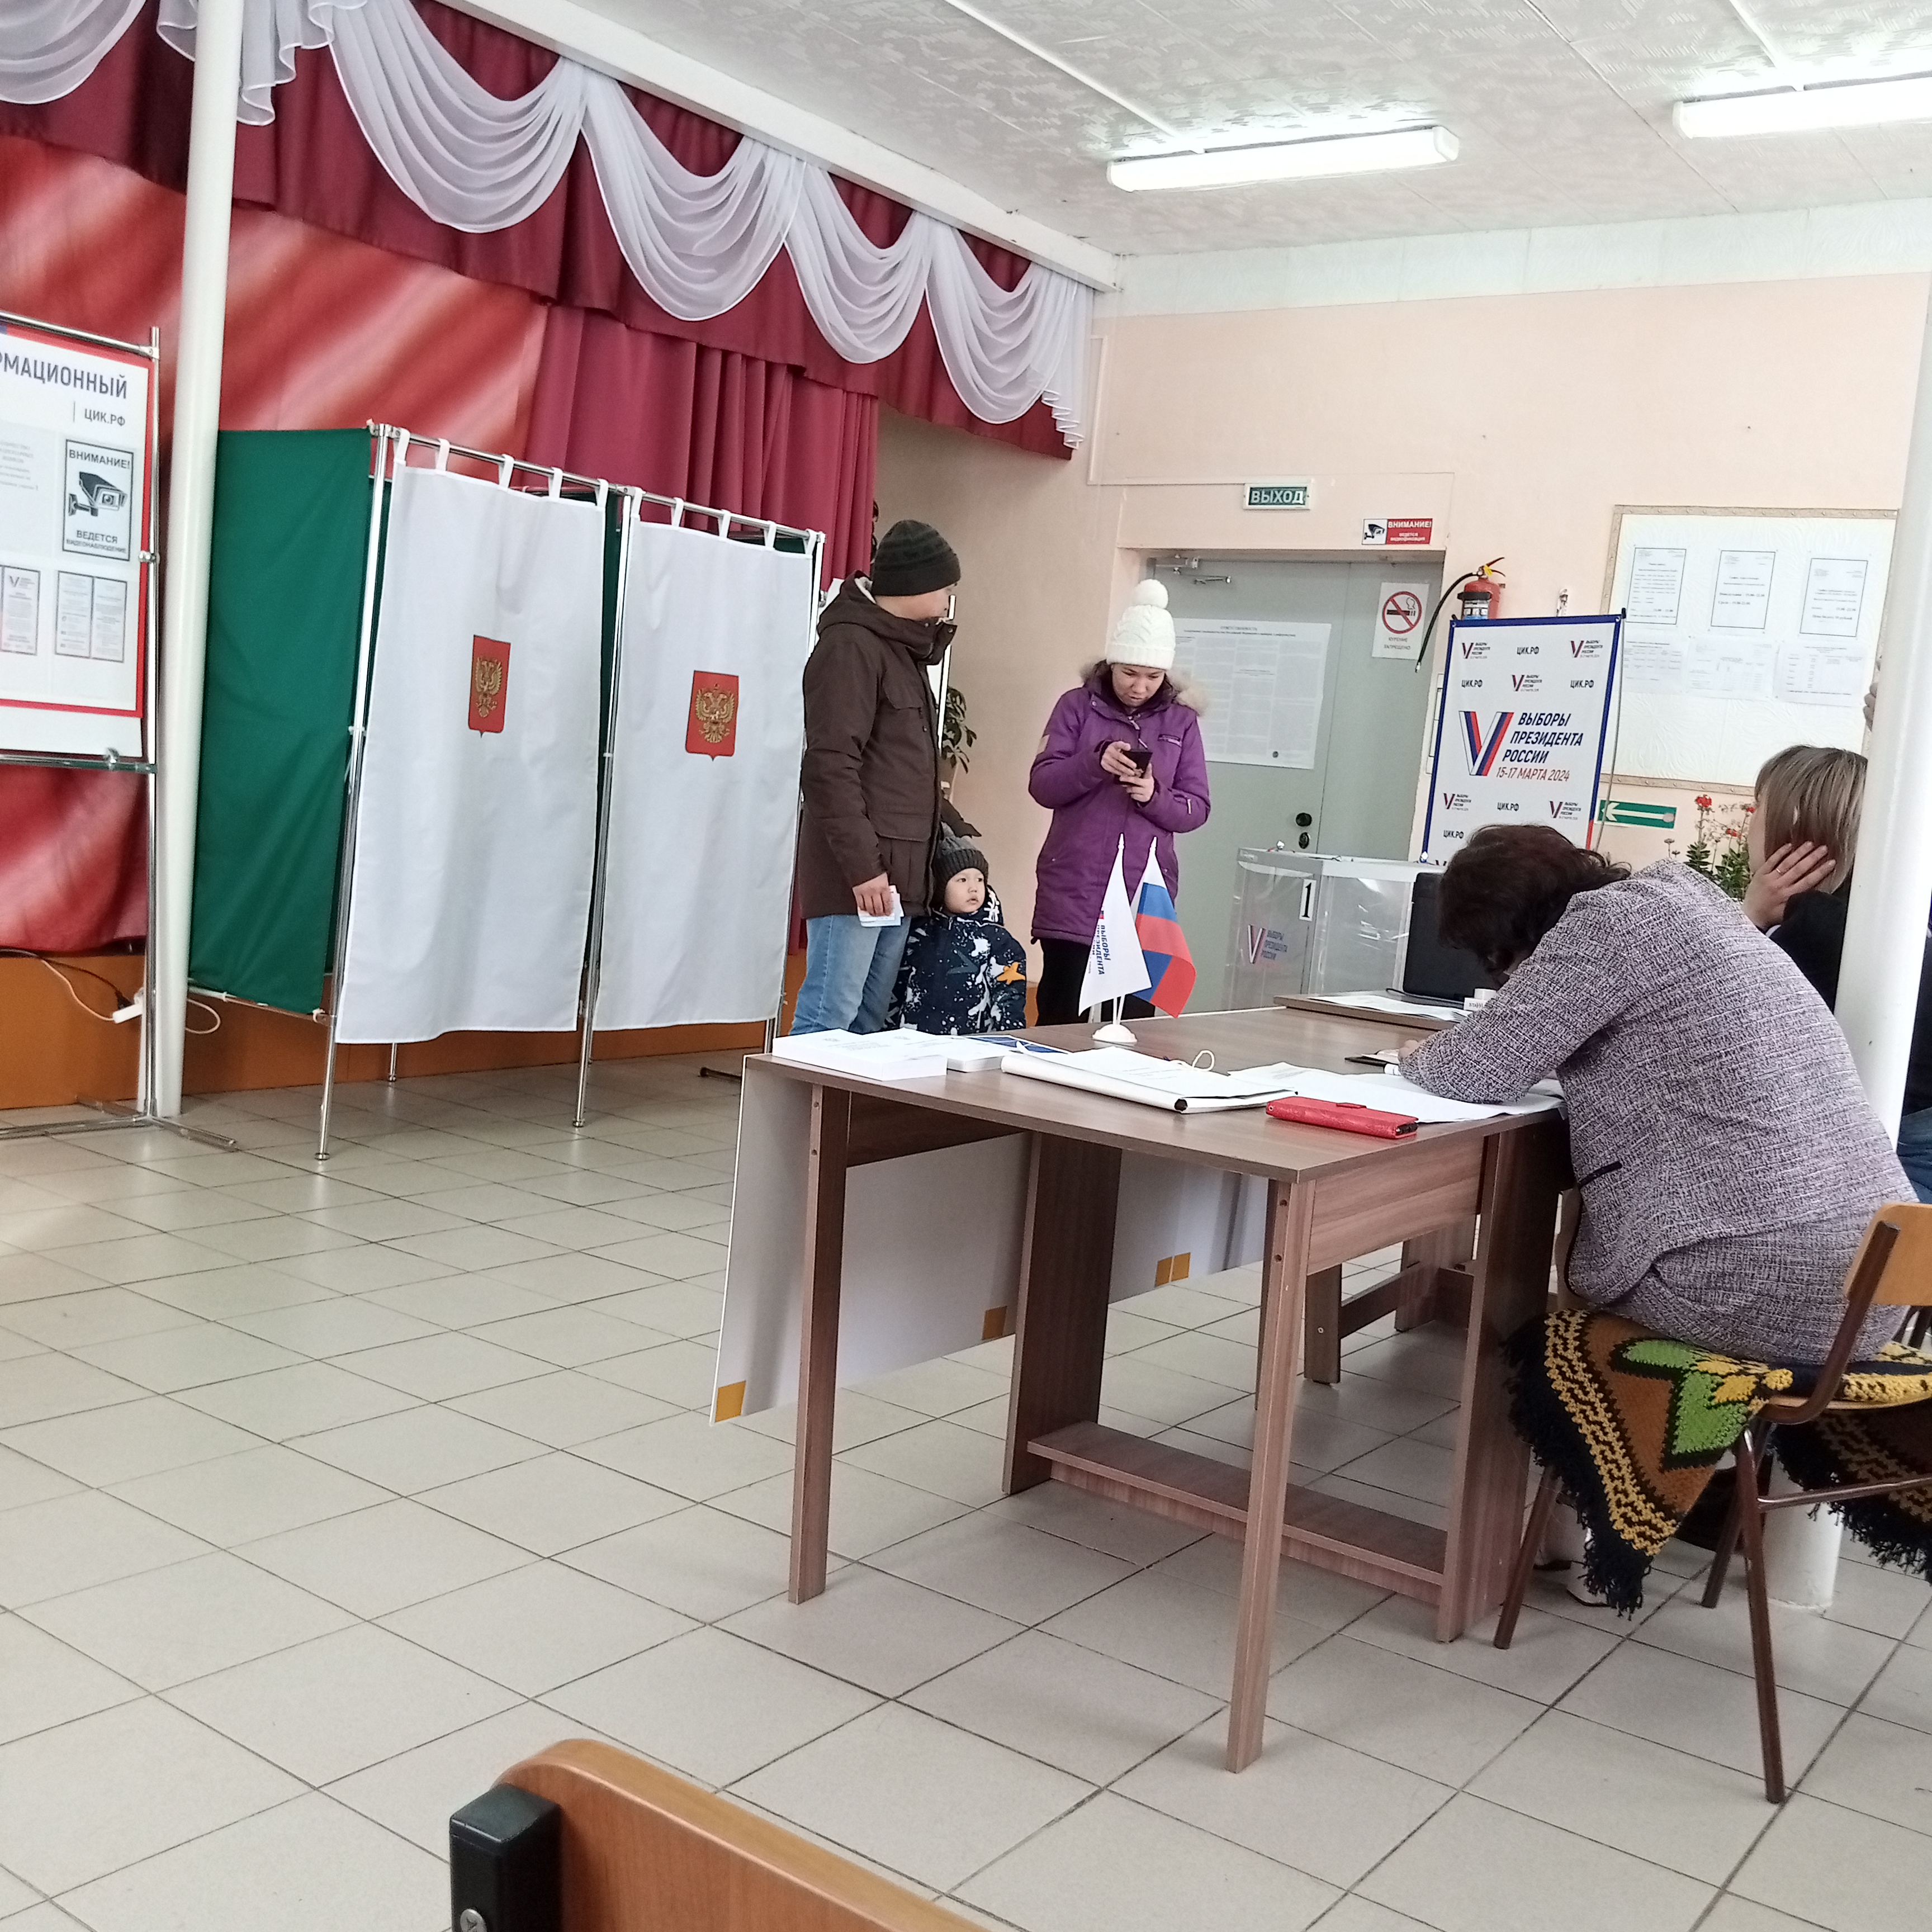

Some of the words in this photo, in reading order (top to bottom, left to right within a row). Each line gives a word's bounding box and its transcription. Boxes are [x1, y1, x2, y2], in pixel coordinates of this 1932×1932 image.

[0, 352, 127, 399] МАЦИОННЫЙ
[84, 409, 126, 427] ЦИК.РФ
[69, 449, 130, 469] ВНИМАНИЕ!
[1251, 490, 1304, 504] ВЫХОД
[77, 530, 117, 544] ВЕДЕТСЯ
[1517, 646, 1539, 655] ЦИК.РФ
[1461, 679, 1483, 688] ЦИК.РФ
[1570, 680, 1594, 689] ЦИК.РФ
[1518, 712, 1571, 727] ВЫБОРЫ
[1510, 731, 1584, 747] ПРЕЗИДЕНТА
[1502, 749, 1550, 764] РОССИИ
[1496, 766, 1517, 778] 15-17
[1517, 768, 1546, 780] МАРТА
[1547, 770, 1570, 782] 2024
[1497, 802, 1519, 811] ЦИК.РФ
[1443, 830, 1464, 839] ЦИК.РФ
[1301, 882, 1312, 918] 1
